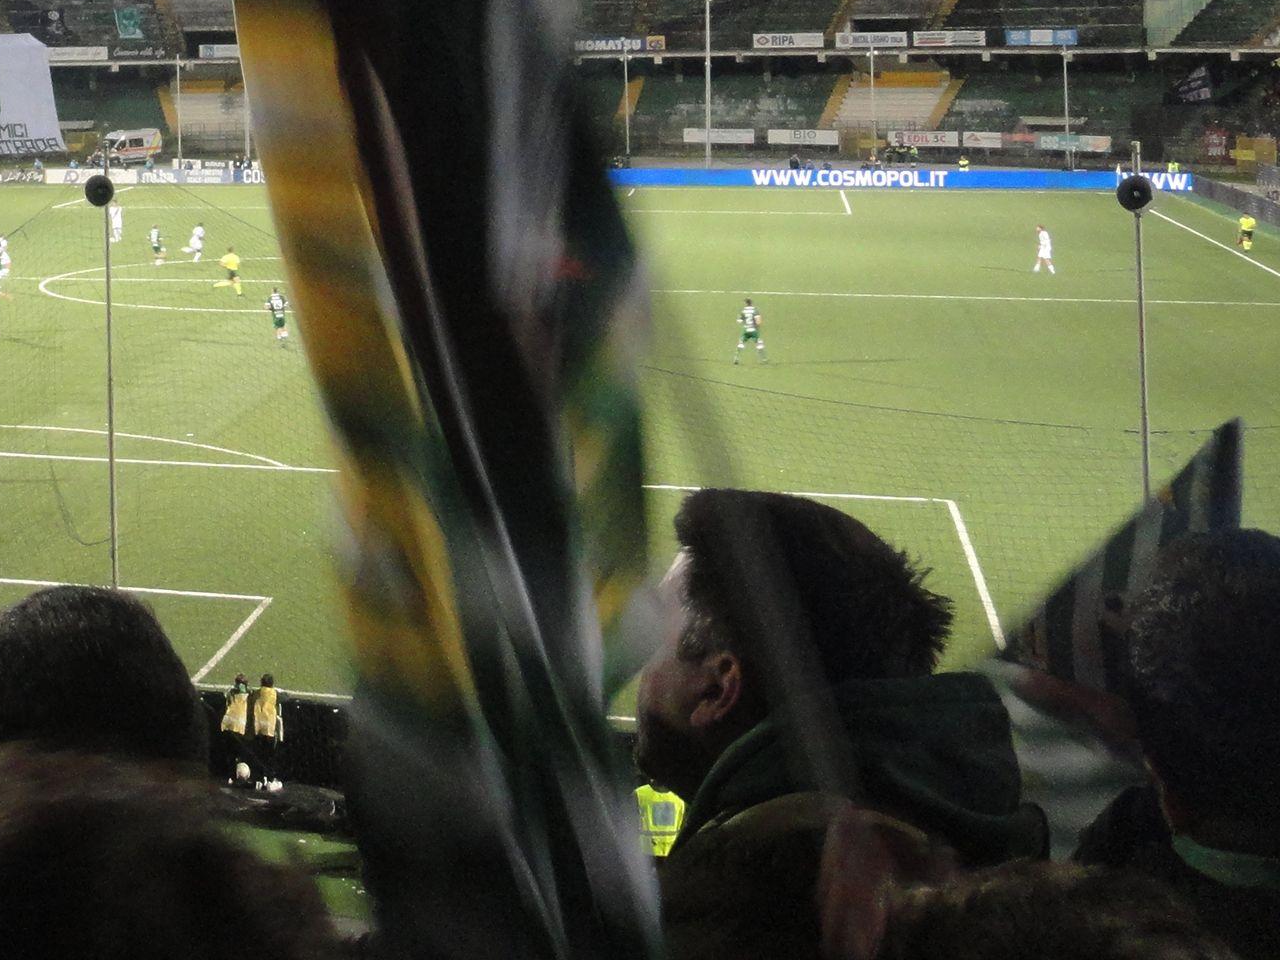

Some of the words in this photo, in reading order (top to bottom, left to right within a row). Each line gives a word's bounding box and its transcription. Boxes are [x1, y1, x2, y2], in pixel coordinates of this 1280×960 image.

[771, 35, 795, 46] RIPA
[793, 130, 817, 140] BIO
[752, 169, 948, 187] WWW.COSMOPOL.IT
